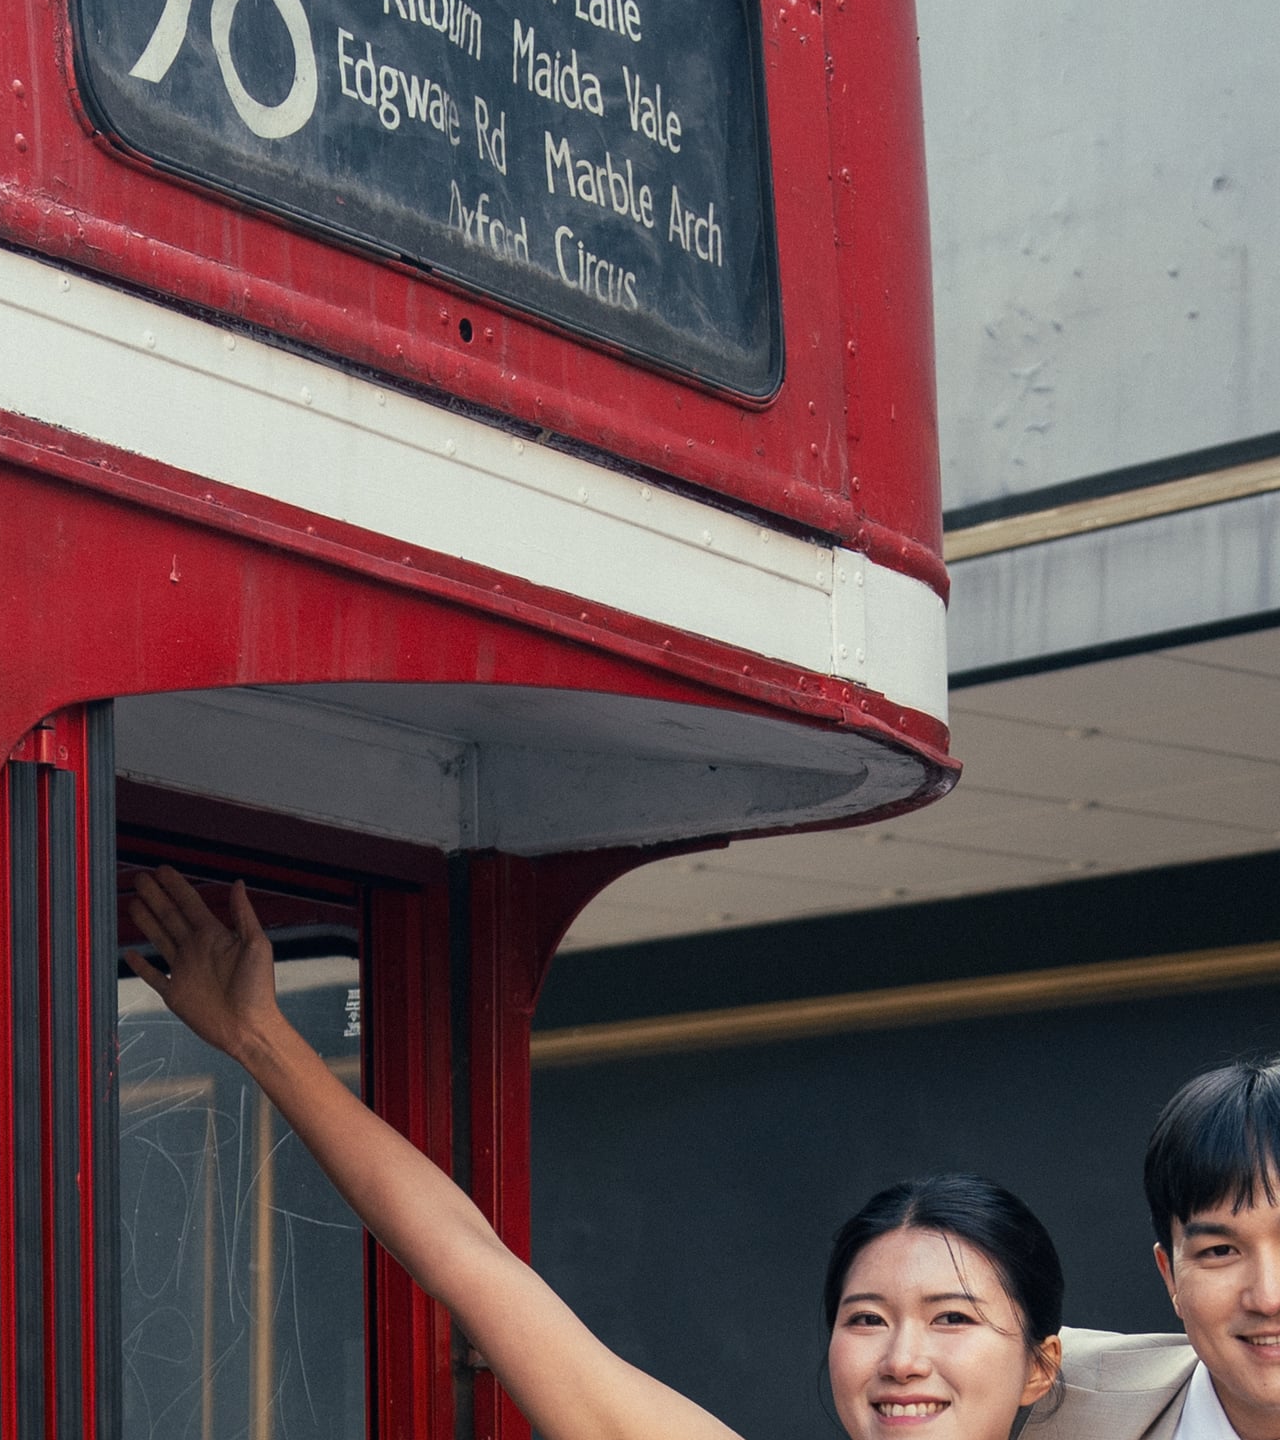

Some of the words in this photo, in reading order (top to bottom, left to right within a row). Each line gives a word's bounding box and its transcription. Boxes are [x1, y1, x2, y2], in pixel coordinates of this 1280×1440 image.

[337, 27, 460, 146] Edgware
[475, 96, 507, 176] Rd
[545, 131, 654, 229] Marble
[669, 185, 722, 267] Arch
[513, 19, 604, 118] Maida
[622, 65, 682, 153] Vale
[554, 226, 638, 310] Circus
